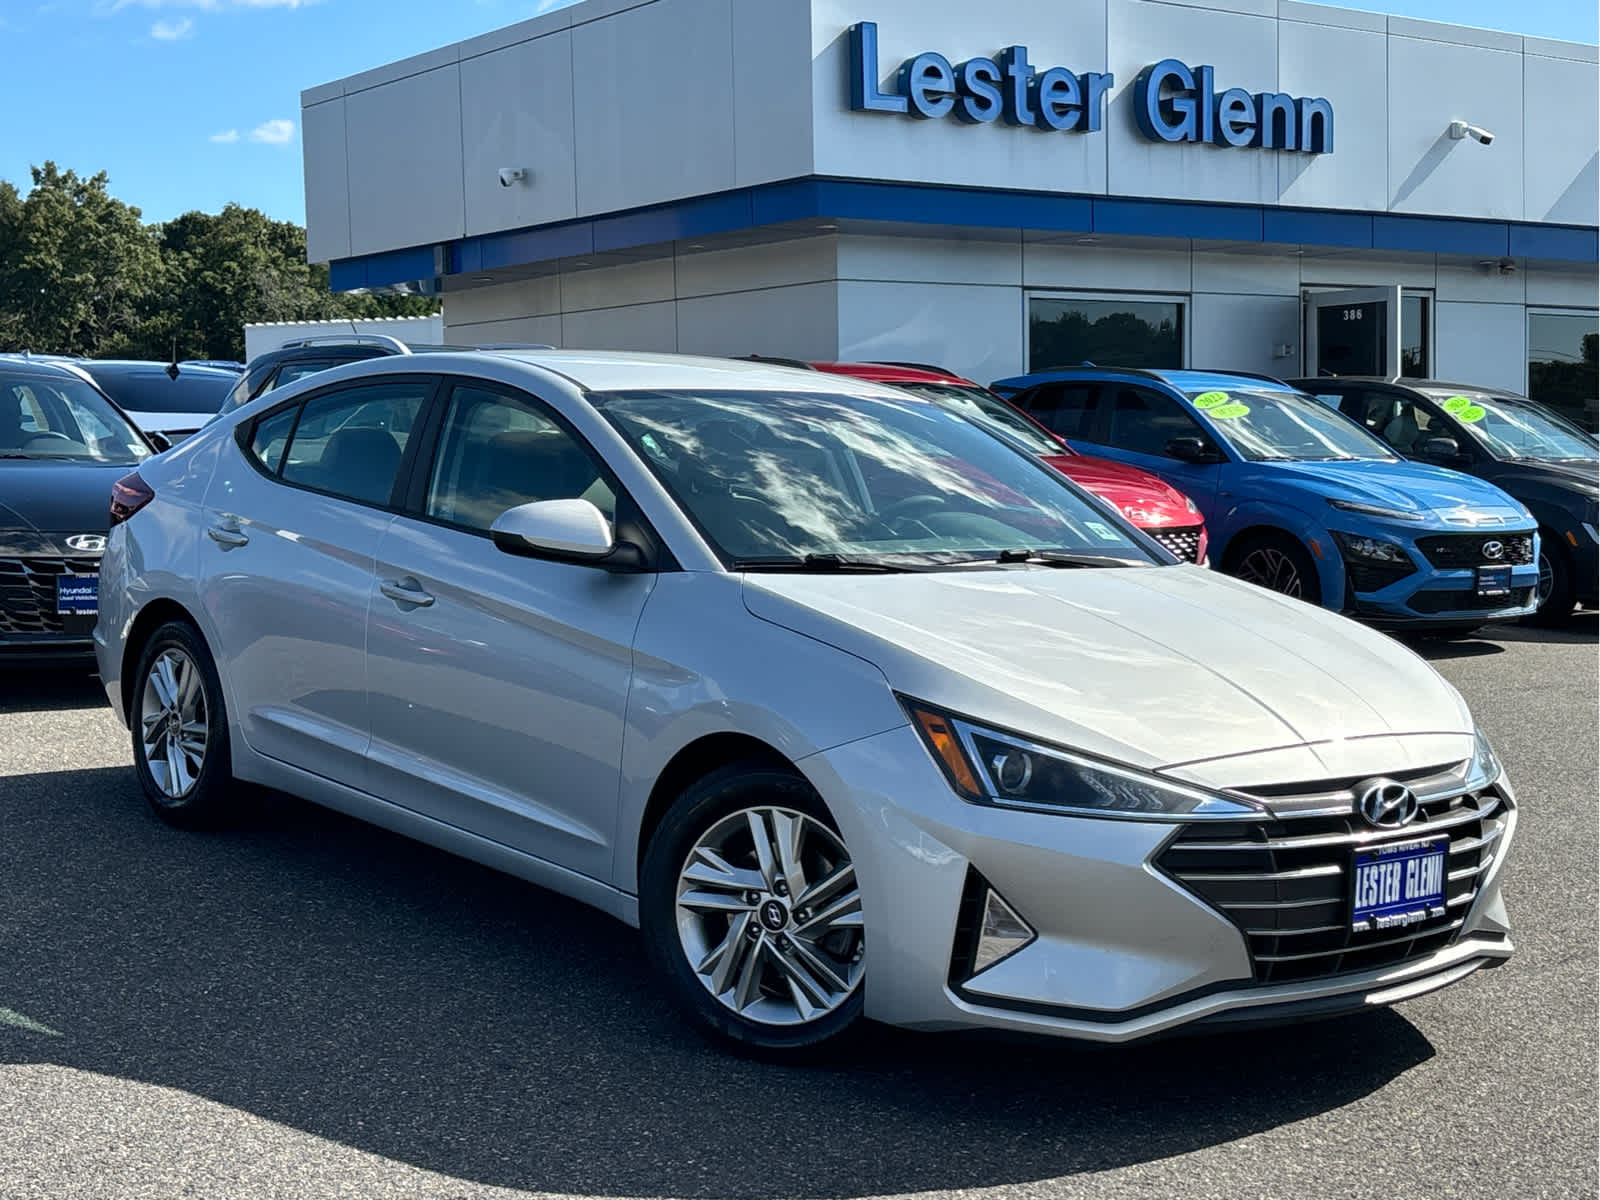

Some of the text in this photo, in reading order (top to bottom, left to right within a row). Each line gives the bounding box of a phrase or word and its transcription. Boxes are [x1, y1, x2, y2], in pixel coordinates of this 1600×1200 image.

[850, 21, 1334, 154] Lester Glenn
[1343, 309, 1363, 321] 386
[60, 586, 92, 596] Hyundai
[1354, 854, 1444, 908] LESTER GLENN
